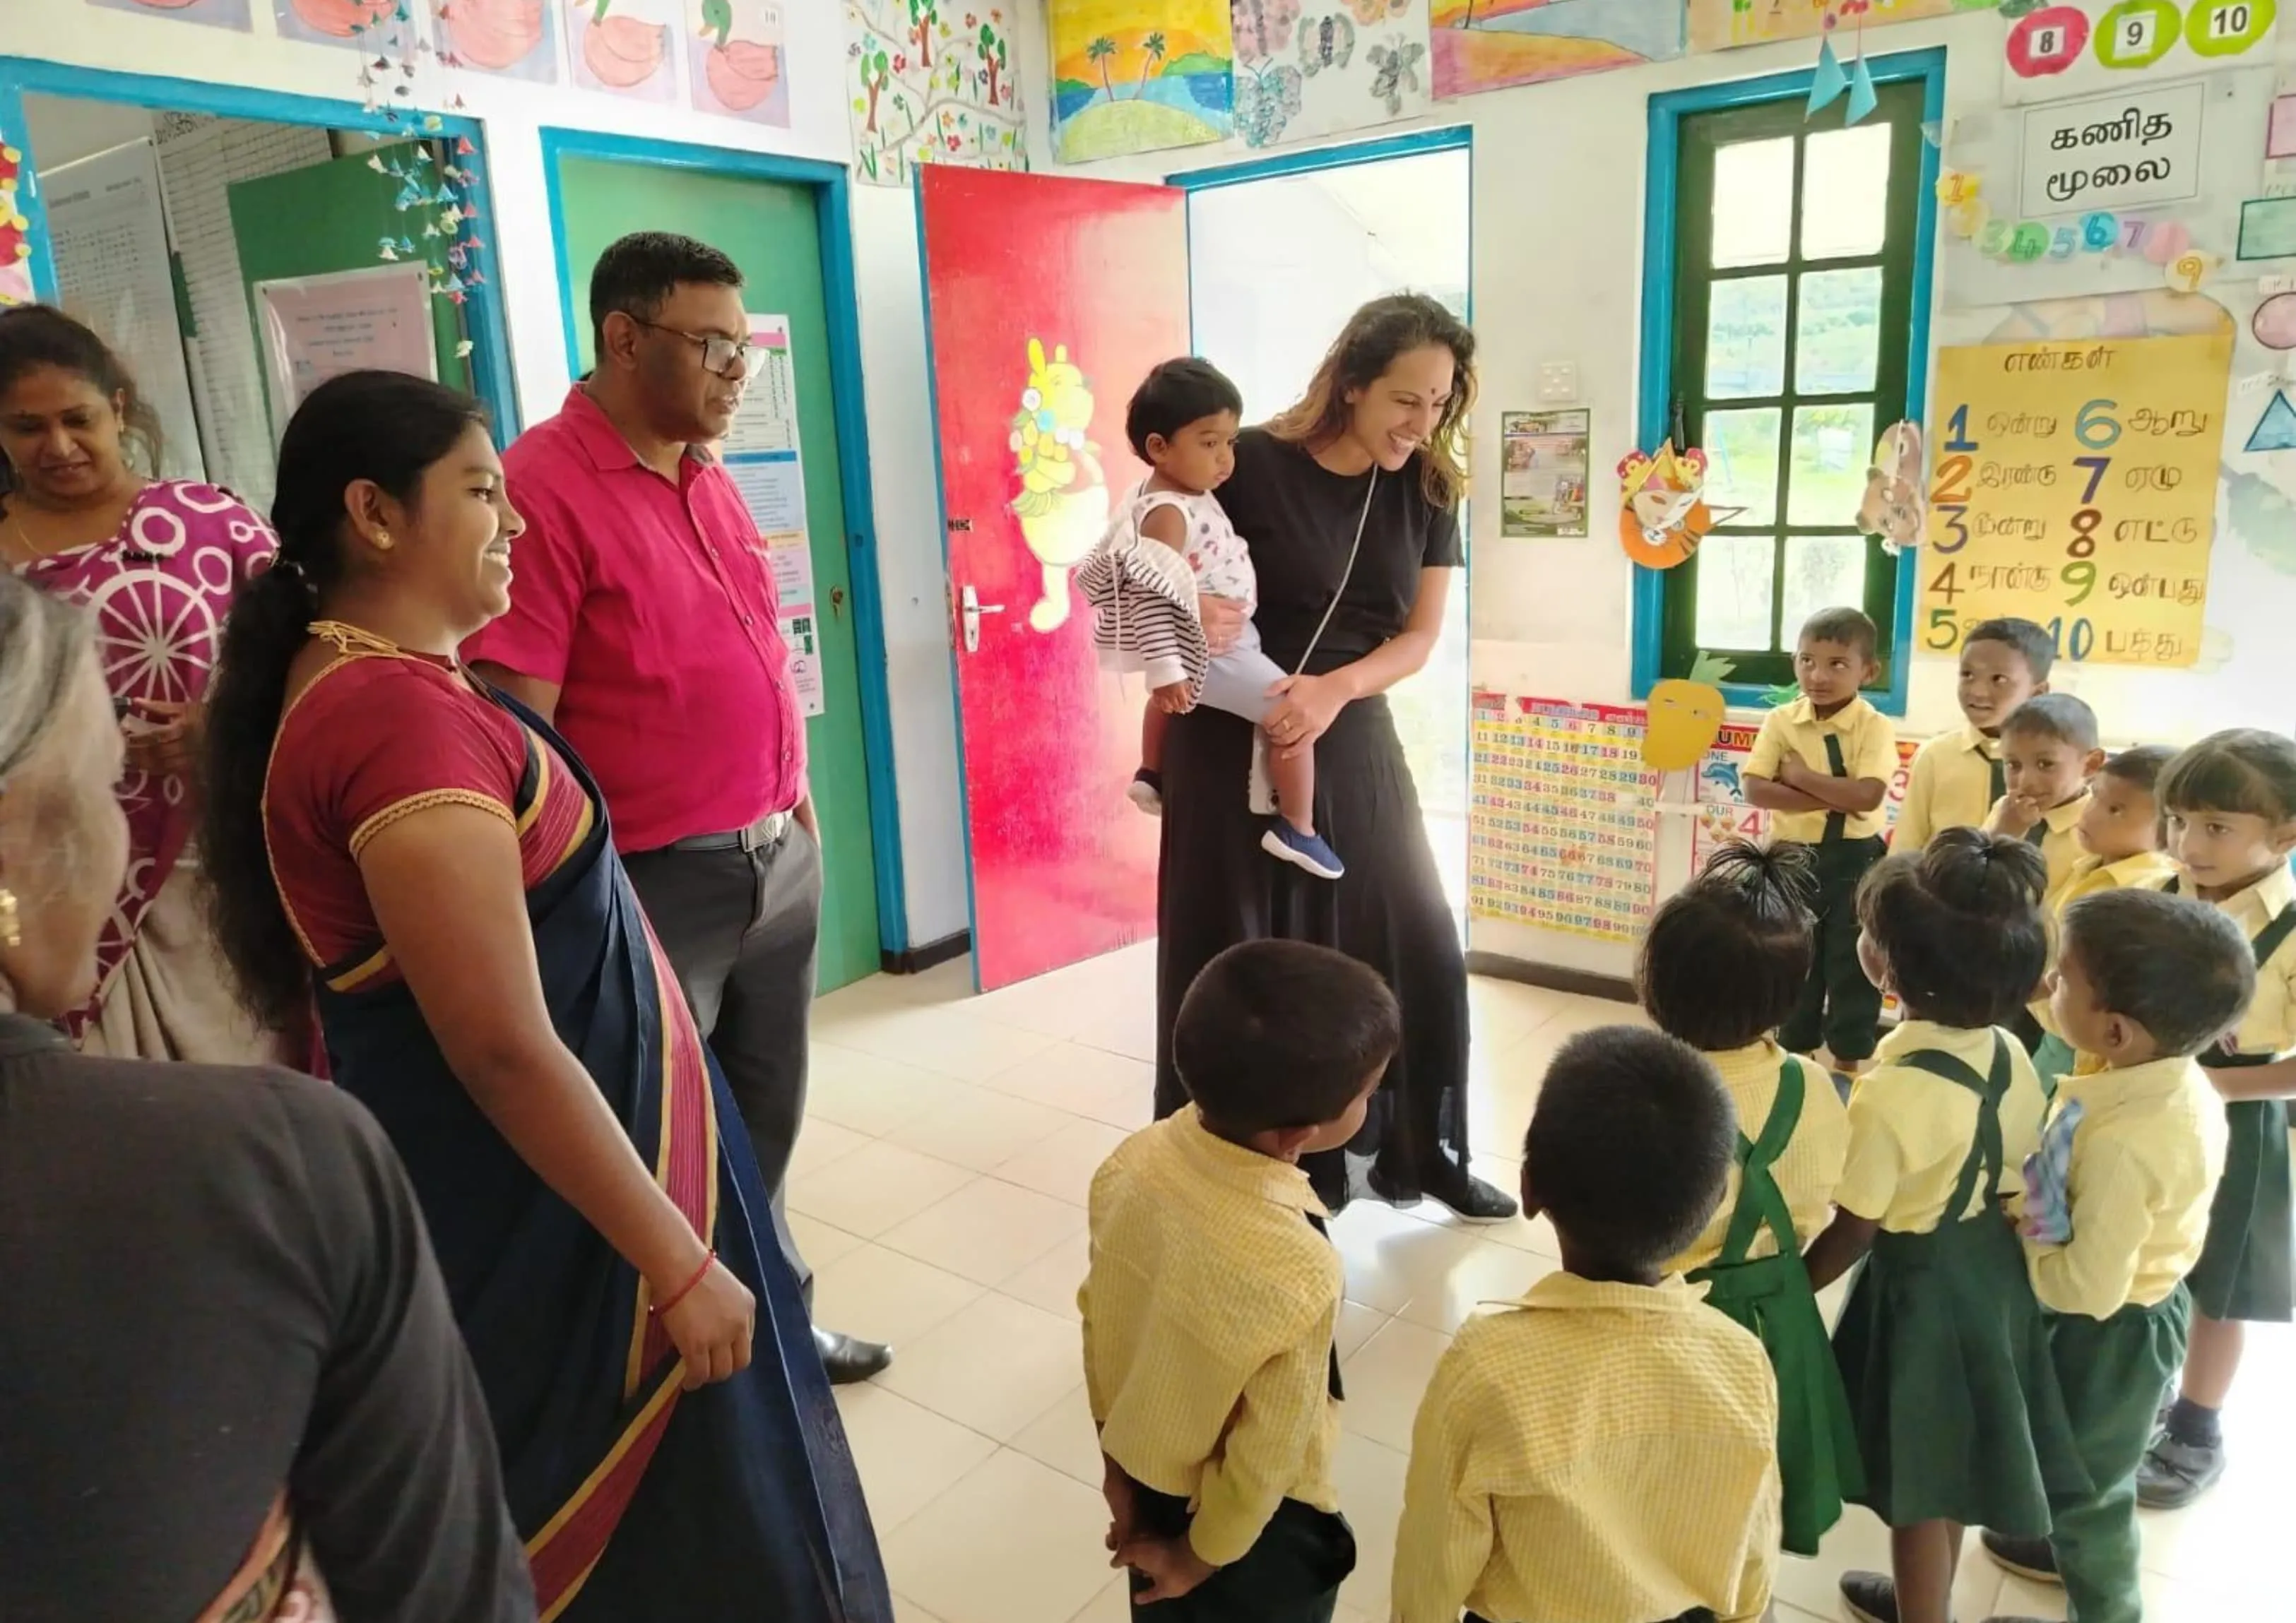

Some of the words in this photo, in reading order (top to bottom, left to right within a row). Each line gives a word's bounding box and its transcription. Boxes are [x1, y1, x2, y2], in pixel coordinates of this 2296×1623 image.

[2039, 30, 2054, 54] 8
[2126, 21, 2144, 46] 9
[2213, 6, 2248, 35] 10
[2050, 107, 2173, 150] கணித
[2046, 157, 2171, 201] மூலை
[1943, 174, 1965, 202] 1
[1980, 219, 2007, 254] 3
[2012, 230, 2042, 259] 4
[2049, 227, 2077, 260] 5
[2085, 215, 2108, 246] 6
[2124, 220, 2147, 249] 7
[2176, 256, 2203, 287] 9
[2004, 345, 2118, 373] எண்கள்
[1944, 403, 1980, 452] 1
[1987, 411, 2058, 438] ஒன்று
[2074, 398, 2122, 450] 6
[2128, 406, 2208, 436] ஆறு
[1930, 455, 1973, 504] 2
[1976, 460, 2057, 489] இரண்டு
[2072, 456, 2113, 505] 7
[1931, 505, 1969, 555] 3
[2066, 508, 2102, 558] 8
[2114, 516, 2198, 545] எட்டு
[1928, 561, 1965, 605] 4
[1970, 561, 2053, 593] நான்கு
[2060, 560, 2097, 607] 9
[2107, 571, 2205, 607] ஒன்பது
[1927, 608, 1958, 650] 5
[2047, 615, 2094, 662] 10
[2105, 628, 2184, 662] பத்து
[1481, 711, 1486, 720] 1
[1533, 718, 1539, 727] 4
[1551, 719, 1558, 727] 5
[1569, 721, 1577, 730] 6
[1588, 723, 1596, 733] 7
[1607, 725, 1616, 735] 8
[1627, 727, 1635, 736] 9
[1477, 732, 1488, 741] 11
[1493, 732, 1508, 743] 12
[1527, 737, 1541, 749] 14
[1546, 740, 1560, 751] 15
[1563, 743, 1578, 754] 16
[1582, 744, 1599, 755] 17
[1602, 747, 1616, 758] 18
[1623, 749, 1637, 759] 19
[1474, 753, 1488, 763] 21
[1492, 754, 1507, 765] 22
[1509, 756, 1524, 767] 23
[1543, 761, 1559, 773] 25
[1561, 763, 1578, 775] 26
[1580, 766, 1597, 778] 27
[1599, 769, 1616, 780] 28
[1619, 772, 1637, 783] 29
[1639, 774, 1657, 786] 30
[1490, 775, 1505, 787] 32
[1525, 780, 1540, 791] 34
[1543, 783, 1558, 794] 35
[1579, 787, 1595, 799] 37
[1599, 790, 1616, 802] 38
[1639, 797, 1654, 807] 40
[1473, 795, 1488, 804] 41
[1580, 809, 1595, 821] 47
[1637, 816, 1653, 829] 50
[1738, 809, 1763, 836] 4
[1522, 823, 1539, 835] 54
[1541, 825, 1558, 836] 55
[1560, 828, 1577, 839] 56
[1579, 831, 1596, 842] 57
[1598, 833, 1615, 845] 58
[1617, 836, 1633, 848] 59
[1636, 839, 1652, 851] 60
[1473, 856, 1484, 865] 71
[1521, 864, 1537, 876] 74
[1540, 867, 1555, 878] 75
[1558, 870, 1575, 881] 76
[1596, 876, 1613, 888] 78
[1633, 881, 1650, 894] 80
[1522, 843, 1539, 854] 64
[1597, 854, 1614, 865] 68
[1635, 861, 1651, 873] 70
[1472, 876, 1485, 885] 81
[1538, 887, 1555, 899] 85
[1557, 891, 1573, 902] 86
[1576, 893, 1592, 905] 87
[1594, 896, 1611, 909] 88
[1633, 901, 1649, 915] 90
[1472, 896, 1484, 905] 91
[1538, 908, 1554, 920] 95
[1556, 911, 1572, 924] 96
[1574, 913, 1592, 926] 97
[1594, 918, 1611, 930] 98
